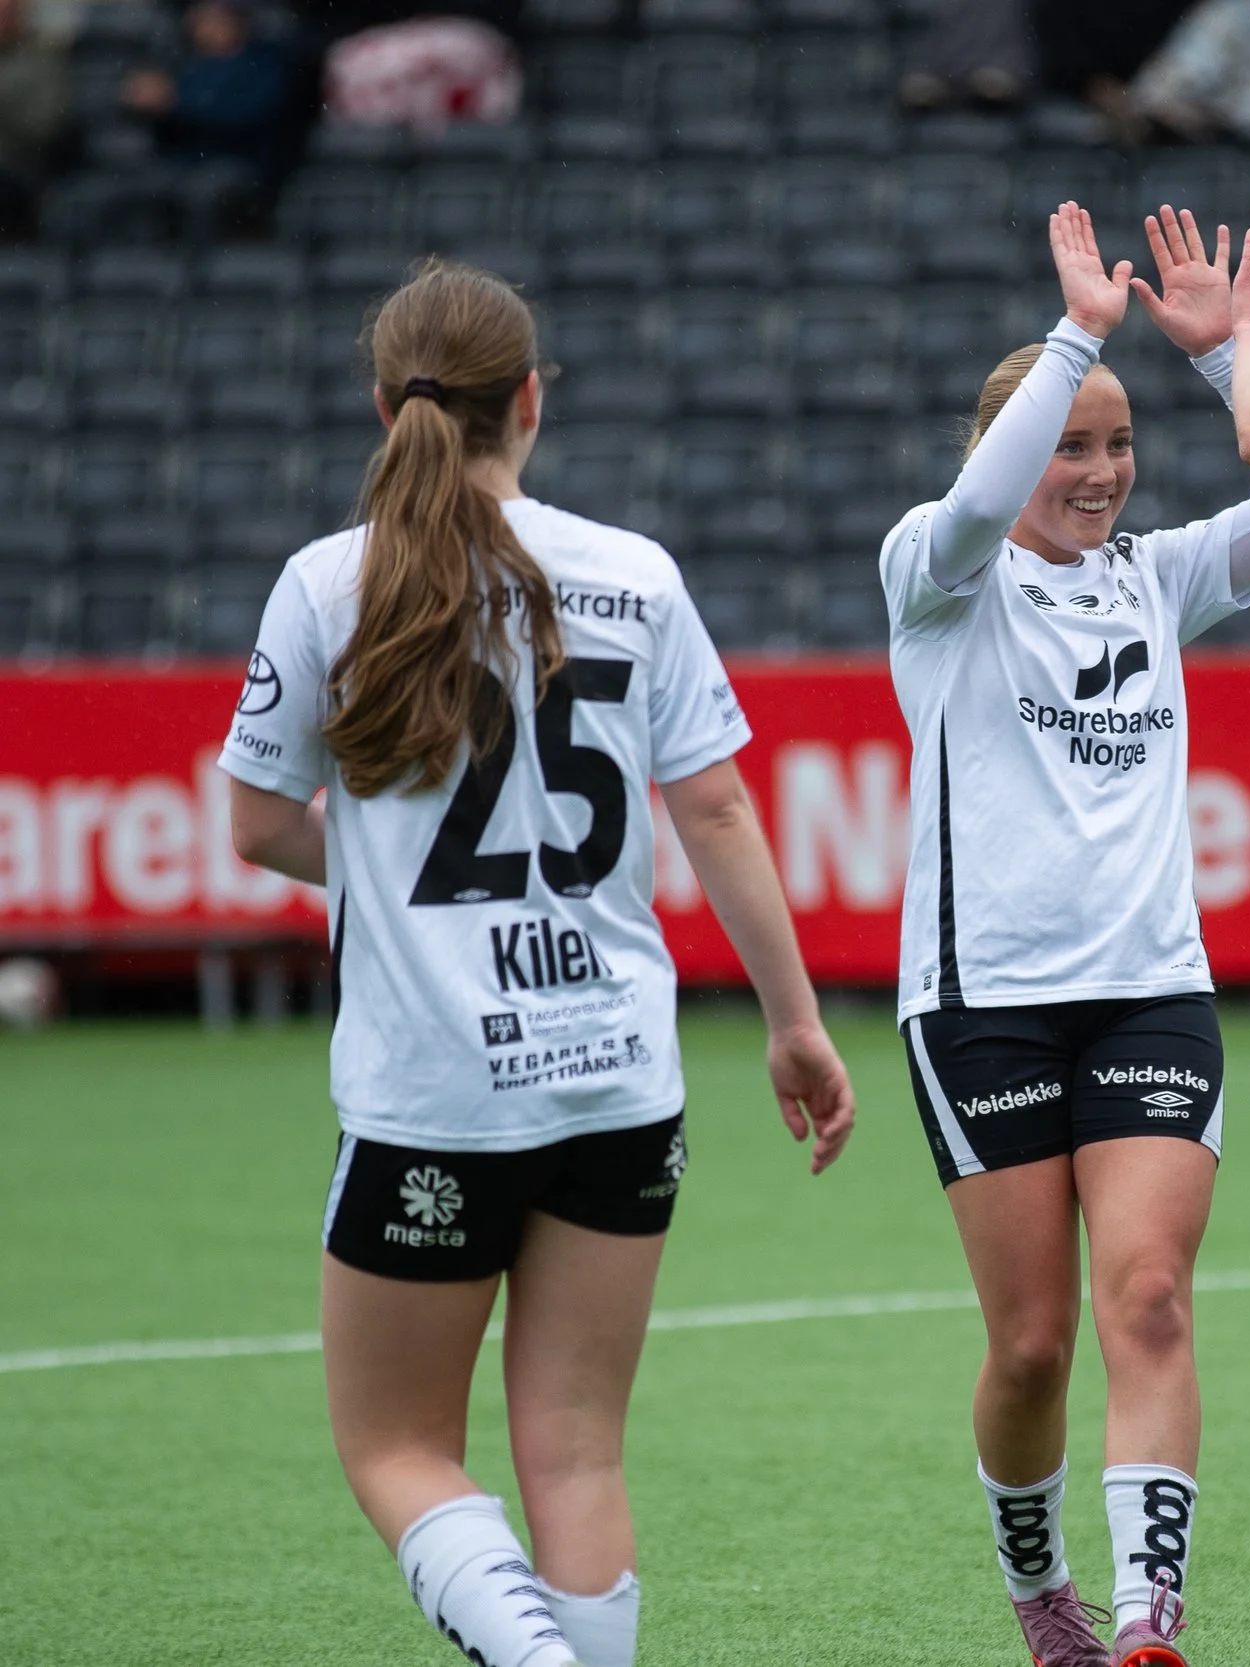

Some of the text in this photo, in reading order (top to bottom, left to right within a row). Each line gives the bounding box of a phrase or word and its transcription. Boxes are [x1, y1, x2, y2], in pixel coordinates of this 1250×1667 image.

[234, 724, 283, 760] Sogn
[1068, 736, 1147, 771] Norge
[408, 655, 634, 907] 25
[1092, 1066, 1210, 1093] Veidekke
[957, 1080, 1064, 1119] Veidekke
[1146, 1107, 1190, 1120] umbro
[384, 1222, 466, 1248] mesta
